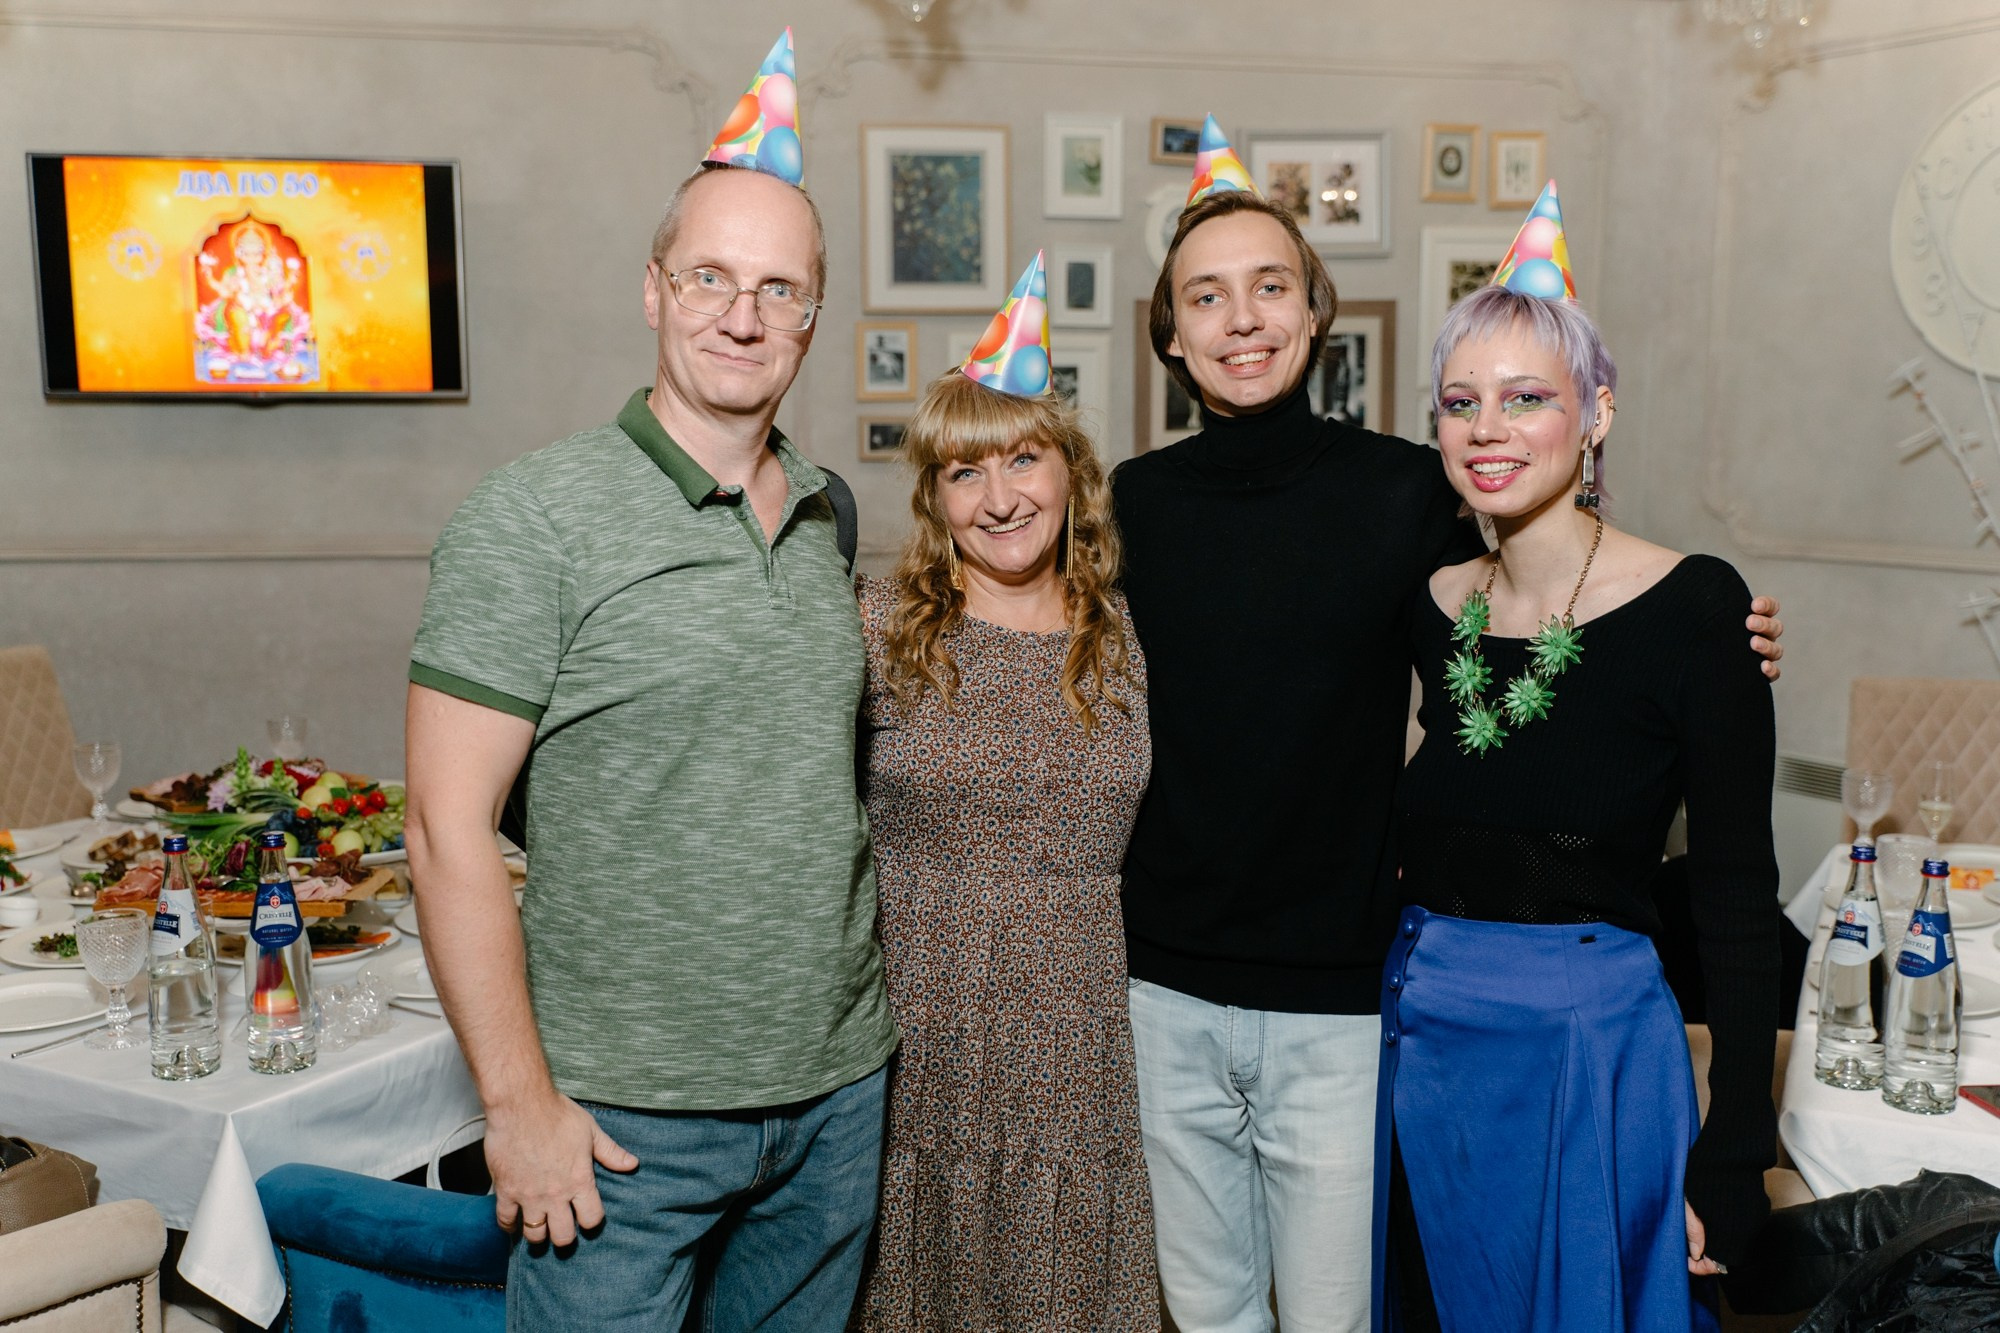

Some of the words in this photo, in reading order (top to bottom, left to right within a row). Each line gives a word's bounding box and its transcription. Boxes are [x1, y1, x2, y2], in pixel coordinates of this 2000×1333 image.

[177, 171, 232, 198] ДВА
[238, 171, 278, 197] ПО
[284, 172, 319, 197] 50
[258, 911, 293, 920] CRISTELLE
